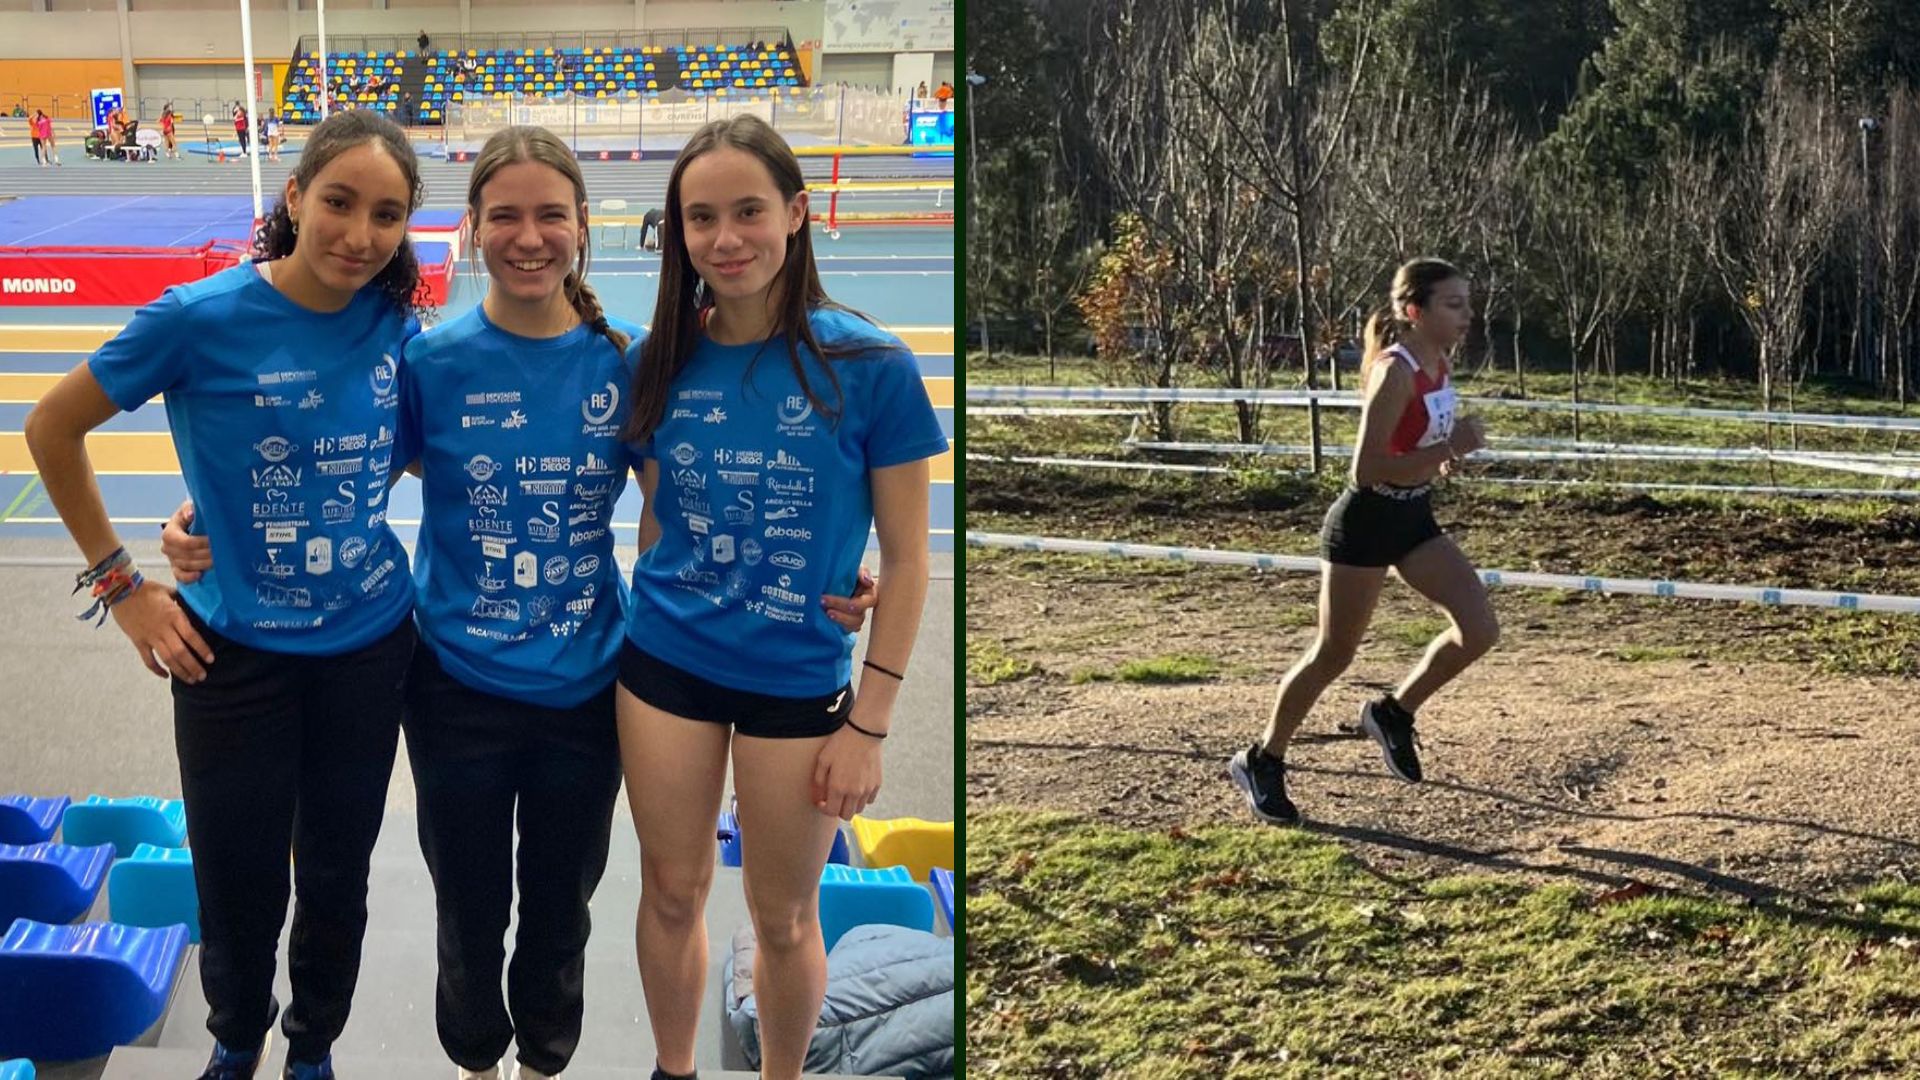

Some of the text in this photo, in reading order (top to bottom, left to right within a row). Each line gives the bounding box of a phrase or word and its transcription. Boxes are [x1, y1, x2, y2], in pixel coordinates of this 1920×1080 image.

[2, 277, 76, 293] MONDO
[375, 365, 391, 381] AE
[591, 394, 608, 409] AE
[786, 395, 804, 410] AE
[540, 462, 571, 472] DIEGO
[253, 502, 305, 514] EDENTE
[469, 519, 513, 532] EDENTE
